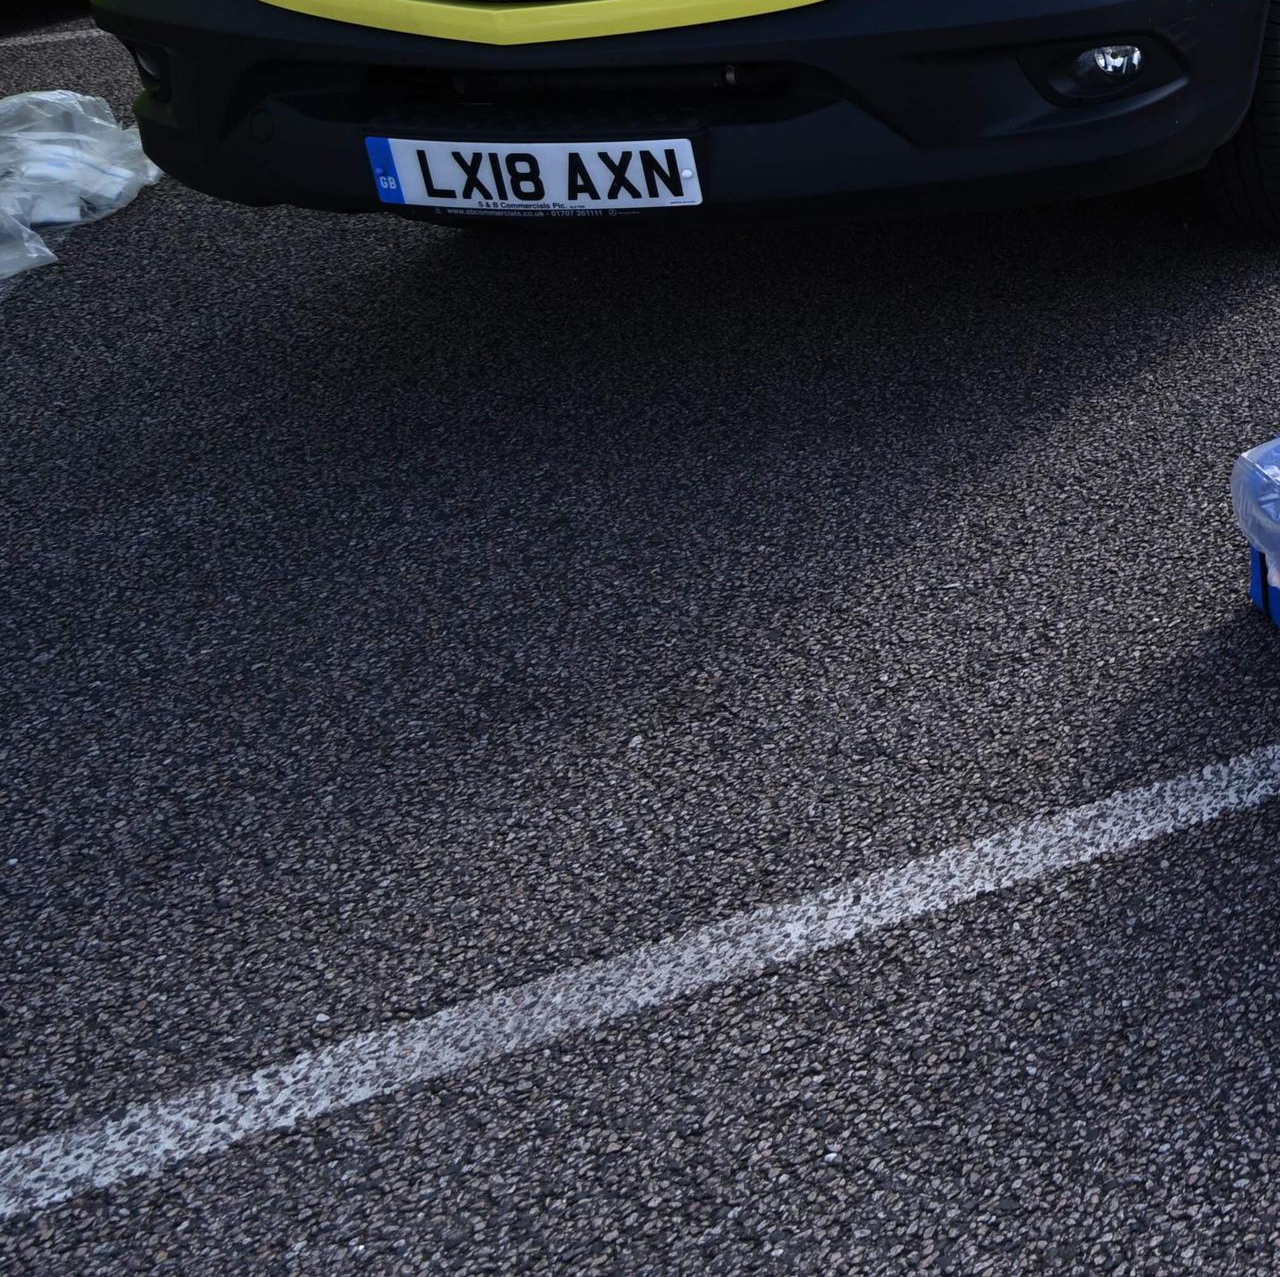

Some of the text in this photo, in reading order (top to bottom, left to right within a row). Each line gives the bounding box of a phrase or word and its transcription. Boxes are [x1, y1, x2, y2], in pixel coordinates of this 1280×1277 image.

[379, 175, 397, 190] GB
[416, 149, 685, 202] LX18 AXN
[500, 202, 551, 210] Commercials
